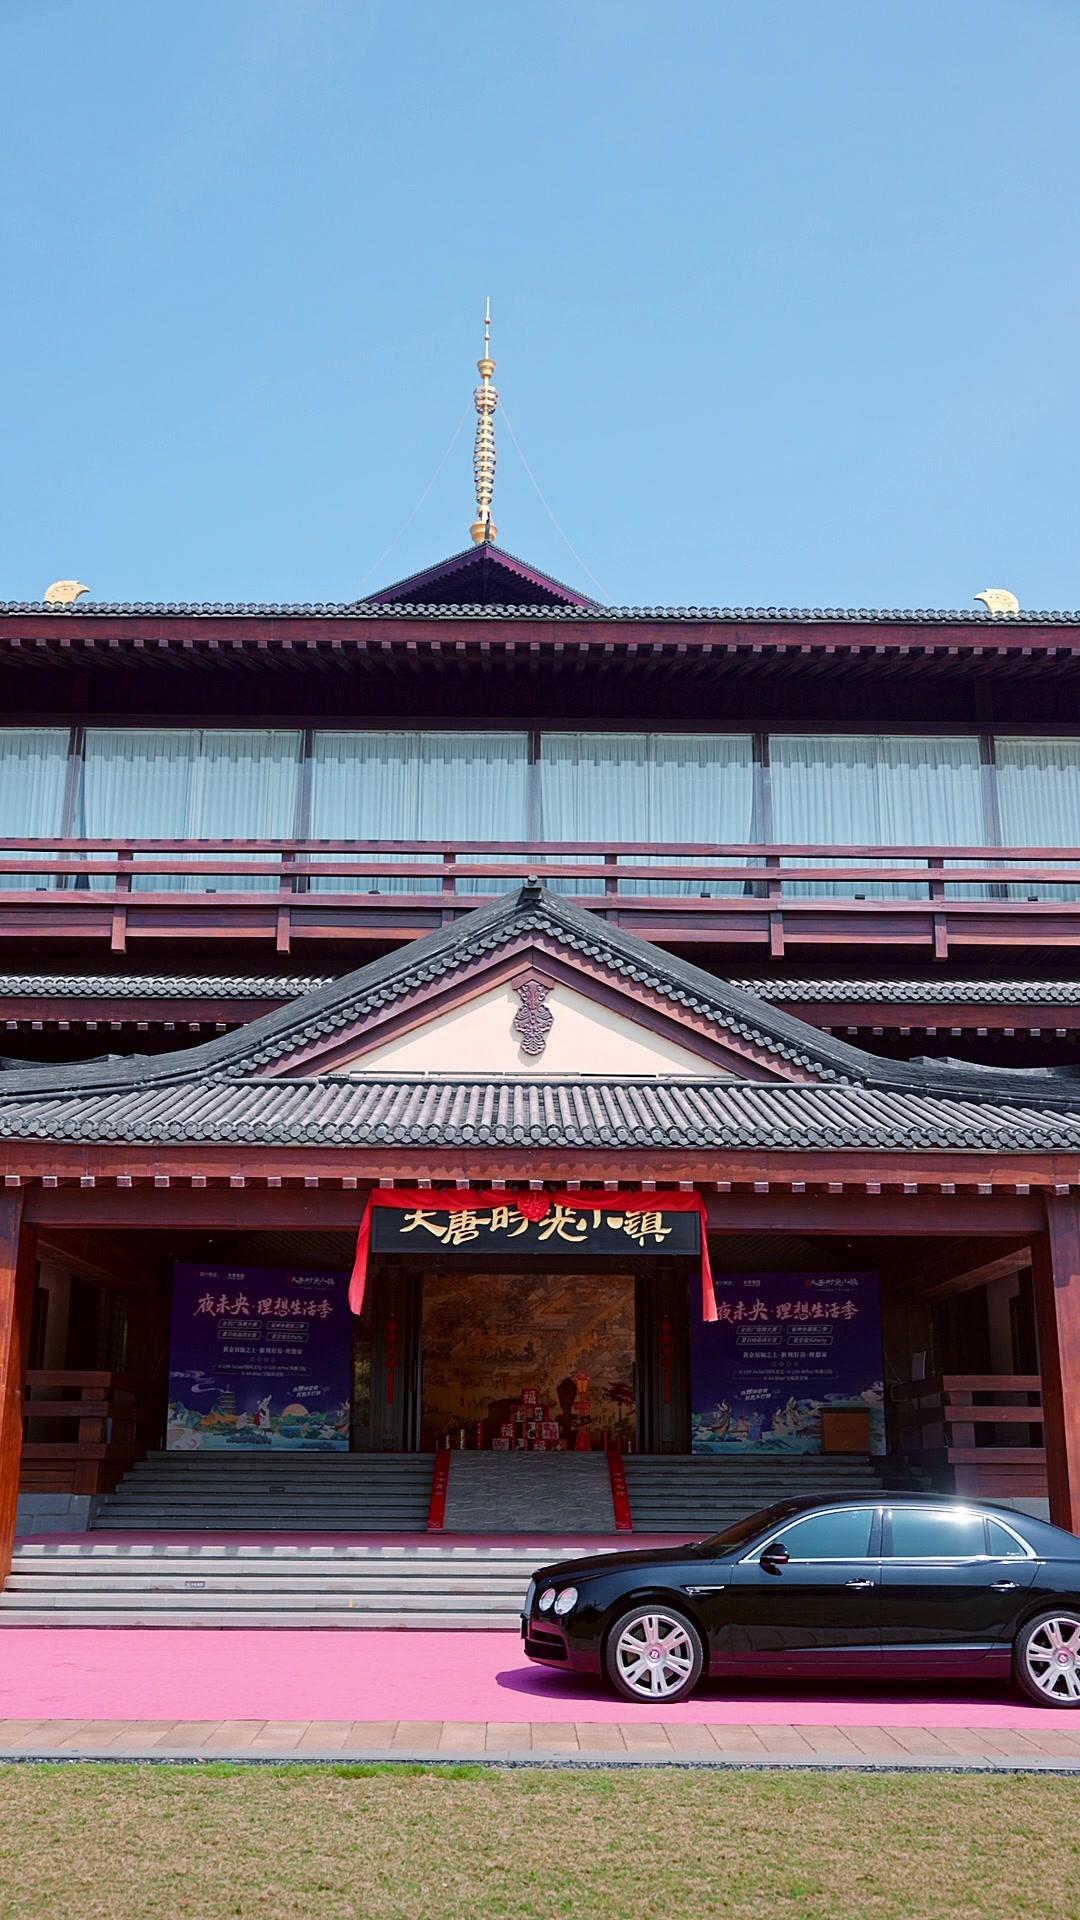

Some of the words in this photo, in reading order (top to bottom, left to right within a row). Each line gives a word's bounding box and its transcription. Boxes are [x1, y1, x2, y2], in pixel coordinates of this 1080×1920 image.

[399, 1205, 672, 1246] 大唐时光小镇
[523, 1391, 537, 1405] 福
[500, 1423, 514, 1437] 福
